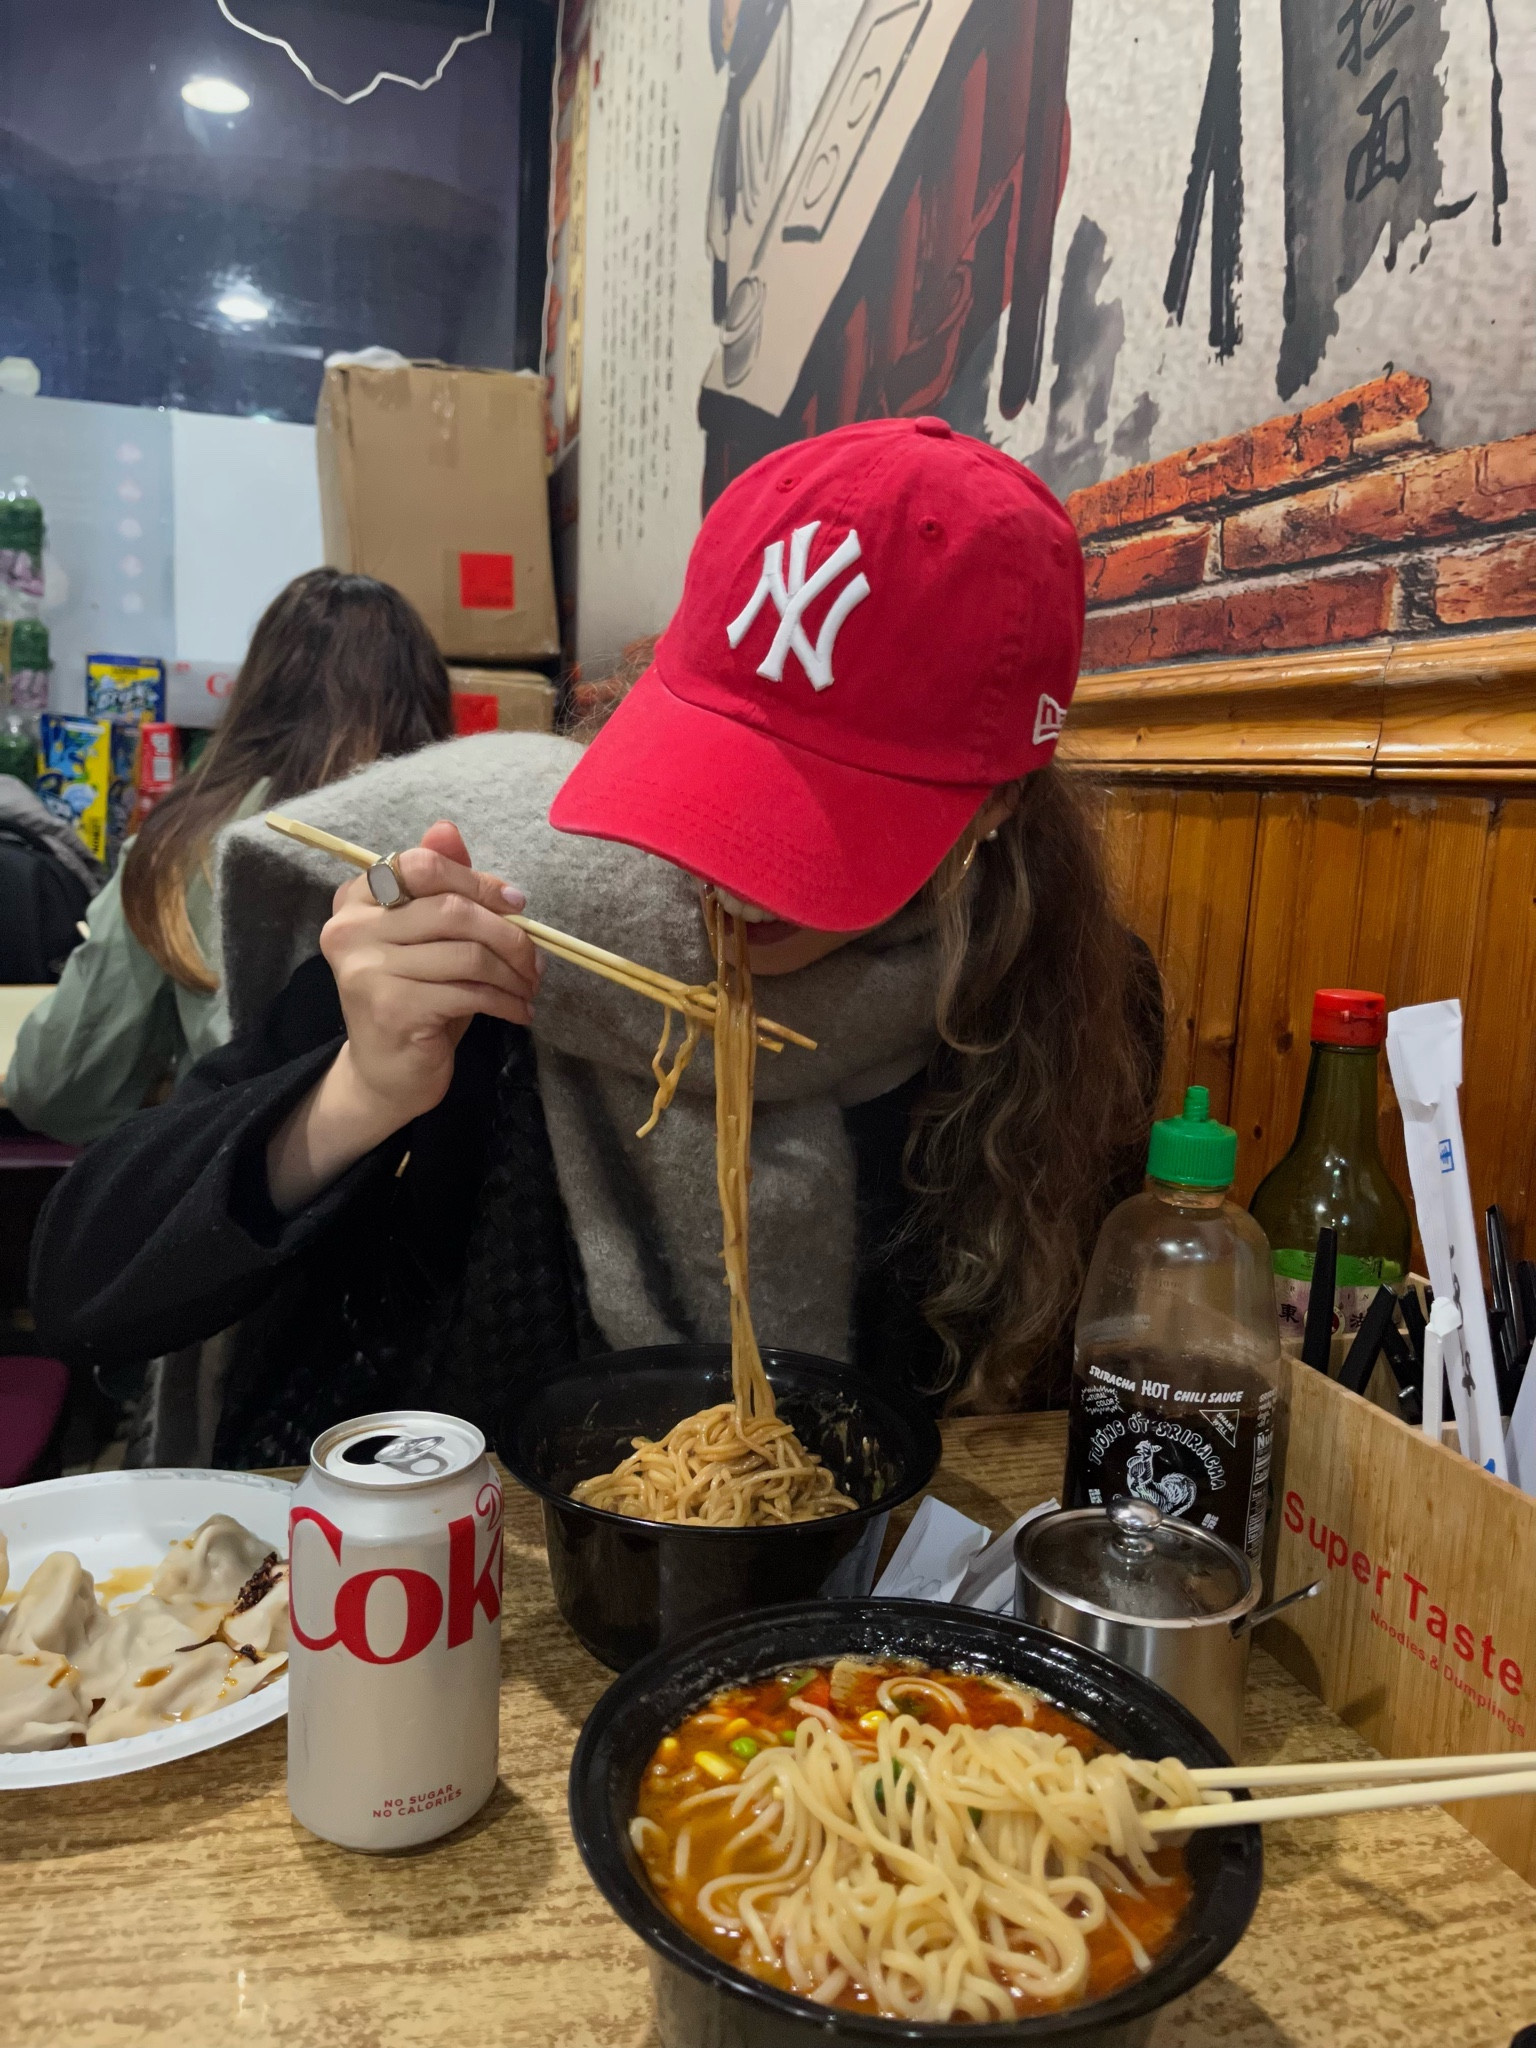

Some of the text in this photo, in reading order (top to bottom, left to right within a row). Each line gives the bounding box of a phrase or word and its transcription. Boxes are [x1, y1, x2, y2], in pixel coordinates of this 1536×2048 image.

[726, 520, 871, 692] NY
[1088, 1365, 1245, 1404] SRIRACHA HOT CHILI SAUCE
[1095, 1397, 1116, 1408] COLOR
[1212, 1418, 1229, 1436] WELL
[1216, 1411, 1236, 1433] SHAKE
[1154, 1420, 1228, 1492] SRIRACHA
[288, 1505, 503, 1665] Cok
[1283, 1490, 1392, 1597] Super
[1402, 1571, 1525, 1697] Taste
[1370, 1607, 1526, 1739] Noodles & Dumplings
[372, 1788, 463, 1818] NO CALORIES
[383, 1783, 454, 1809] NO SUGAR
